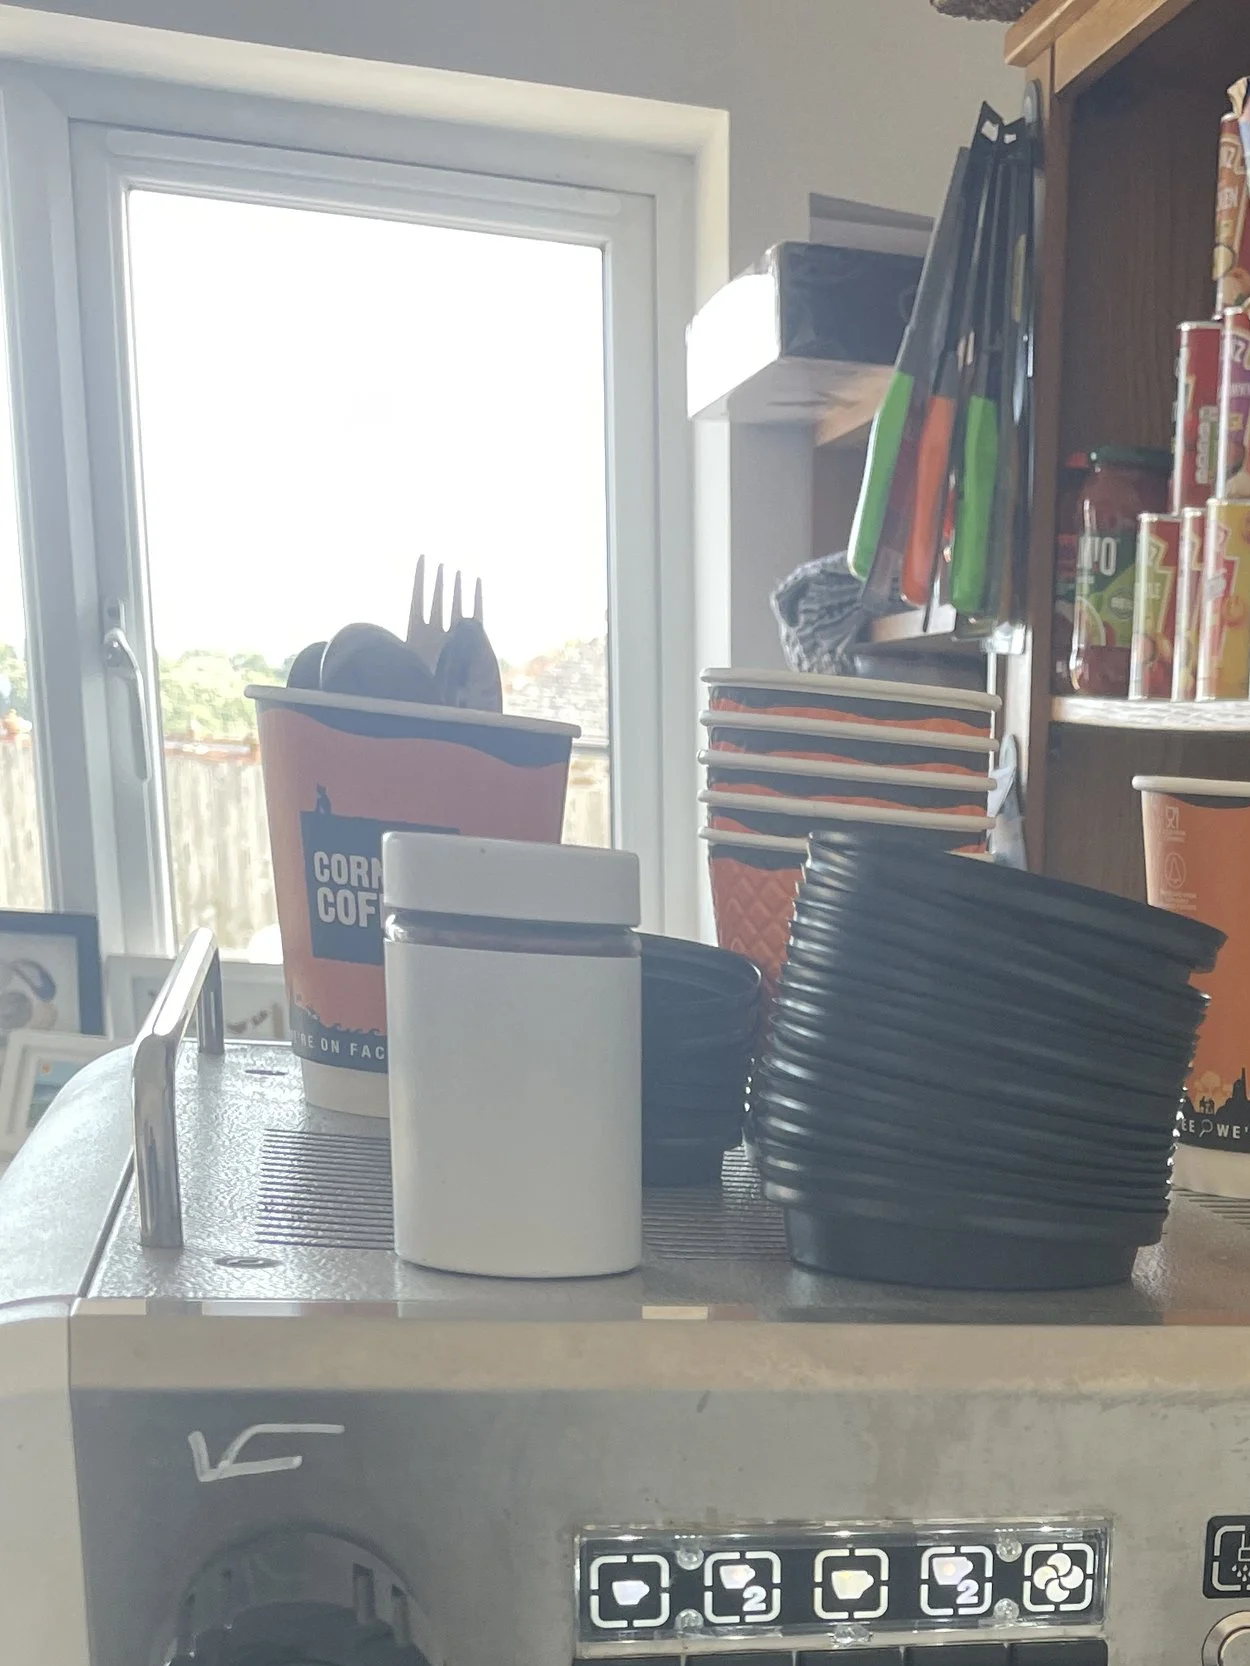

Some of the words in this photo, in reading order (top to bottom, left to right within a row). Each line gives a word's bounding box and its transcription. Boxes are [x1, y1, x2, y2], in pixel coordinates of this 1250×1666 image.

[314, 850, 384, 889] CORN
[317, 887, 384, 929] COF
[320, 1037, 340, 1054] ON
[742, 1585, 766, 1610] 2
[957, 1580, 980, 1604] 2
